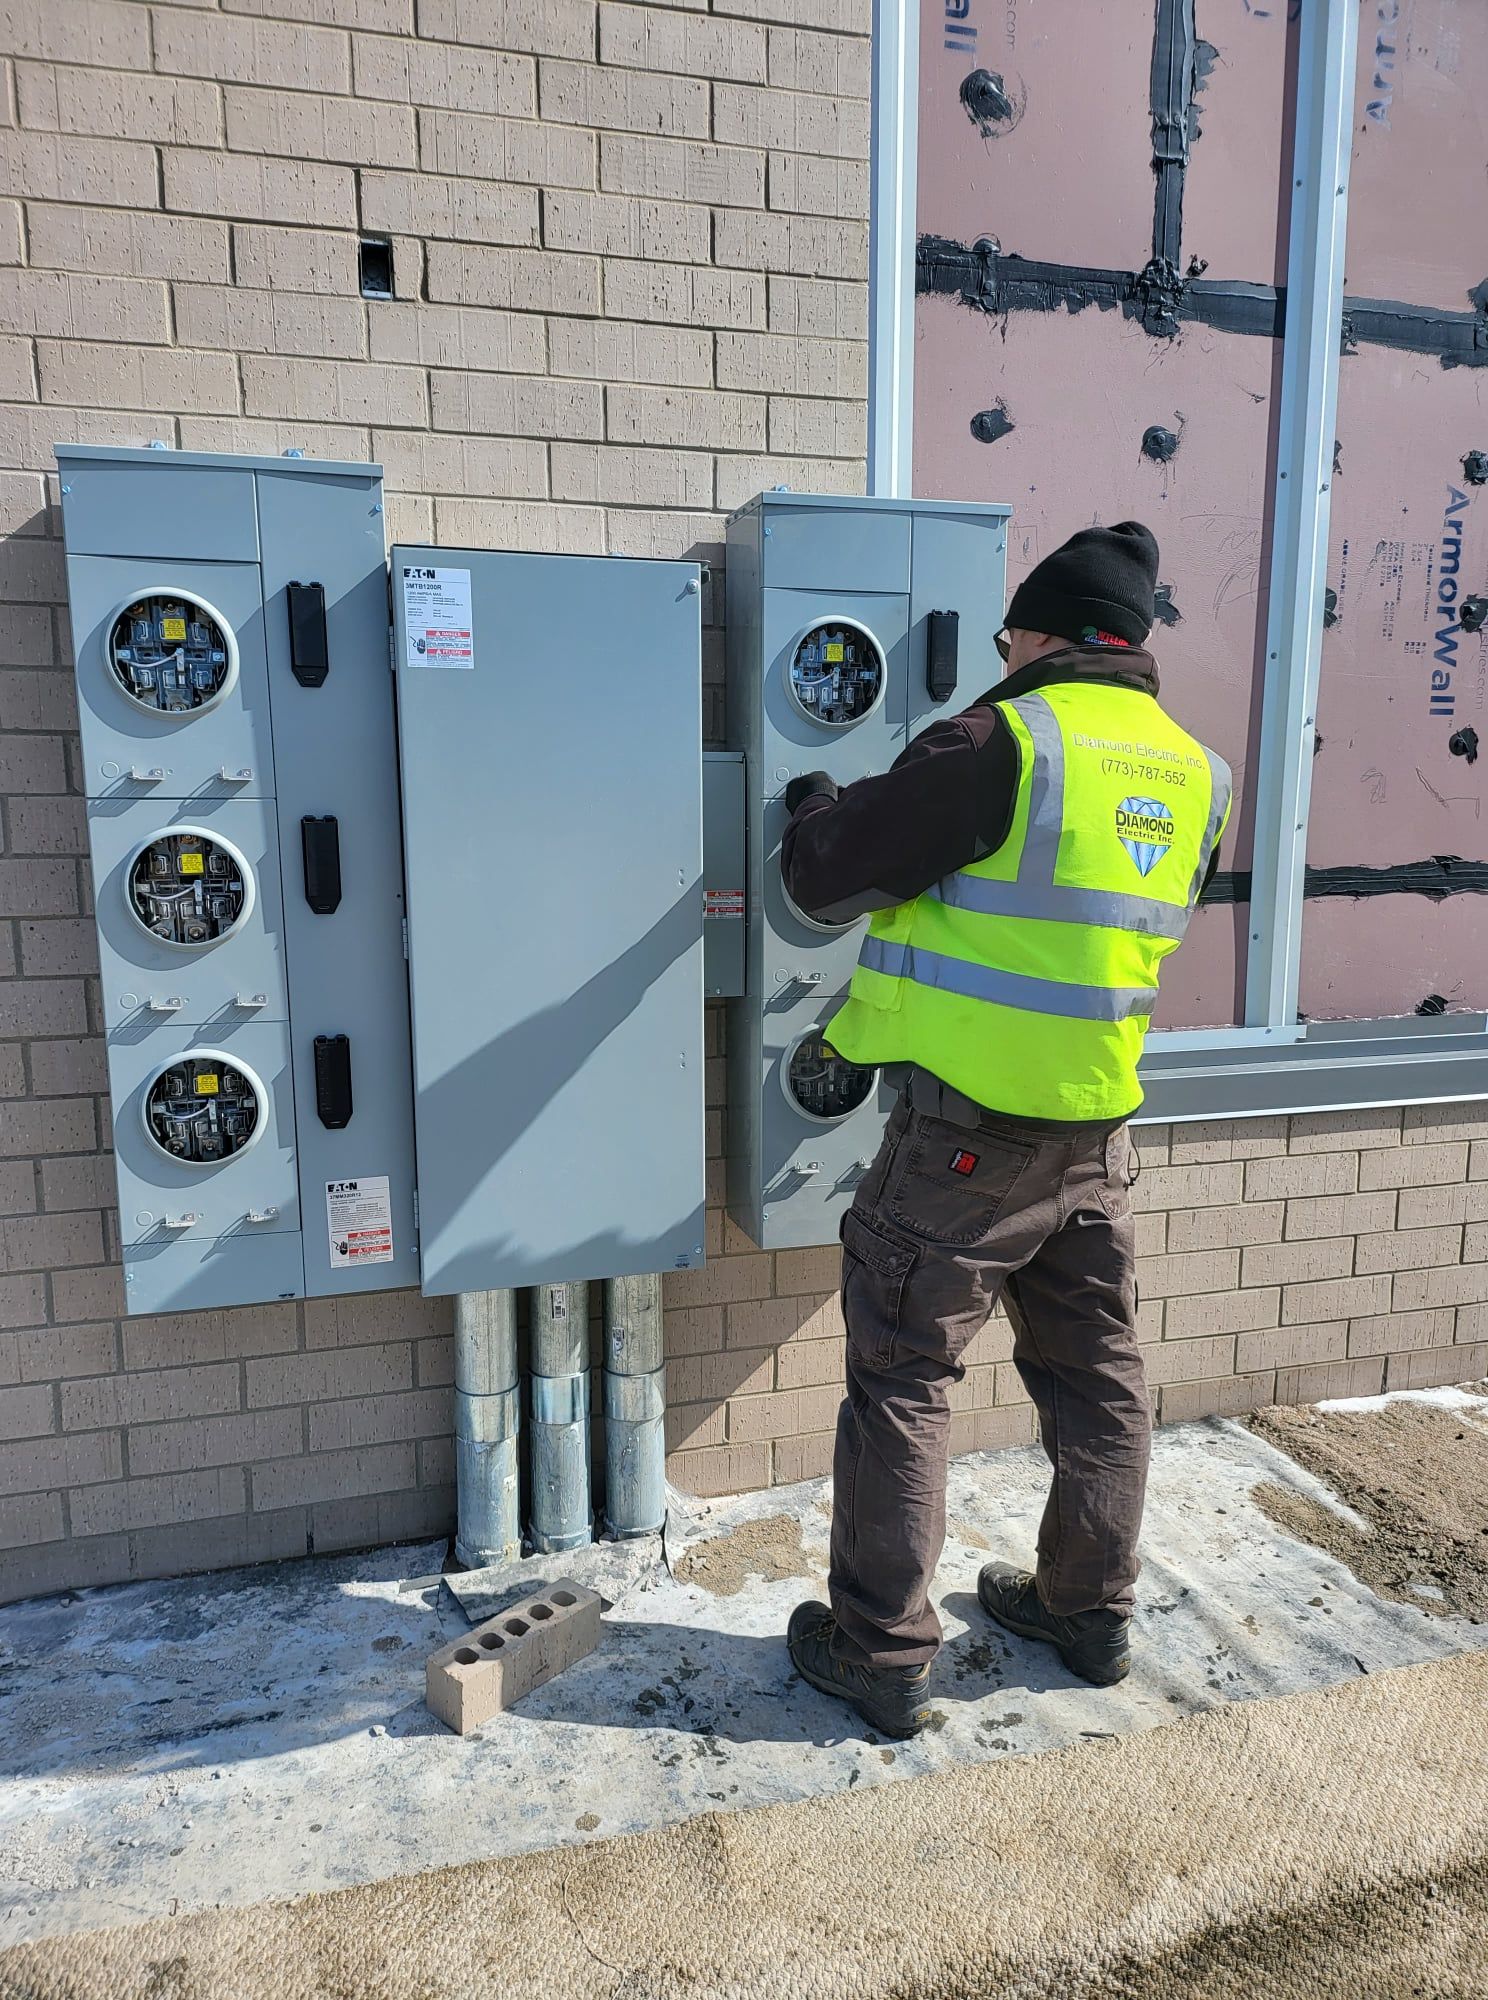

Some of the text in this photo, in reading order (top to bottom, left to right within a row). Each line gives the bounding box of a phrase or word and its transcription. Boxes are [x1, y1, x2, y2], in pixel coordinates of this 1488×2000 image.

[1429, 484, 1471, 717] ArmorWall
[1102, 759, 1186, 787] (773)-787-552
[1116, 810, 1174, 835] DIAMOND
[1117, 828, 1175, 844] Electric Inc.
